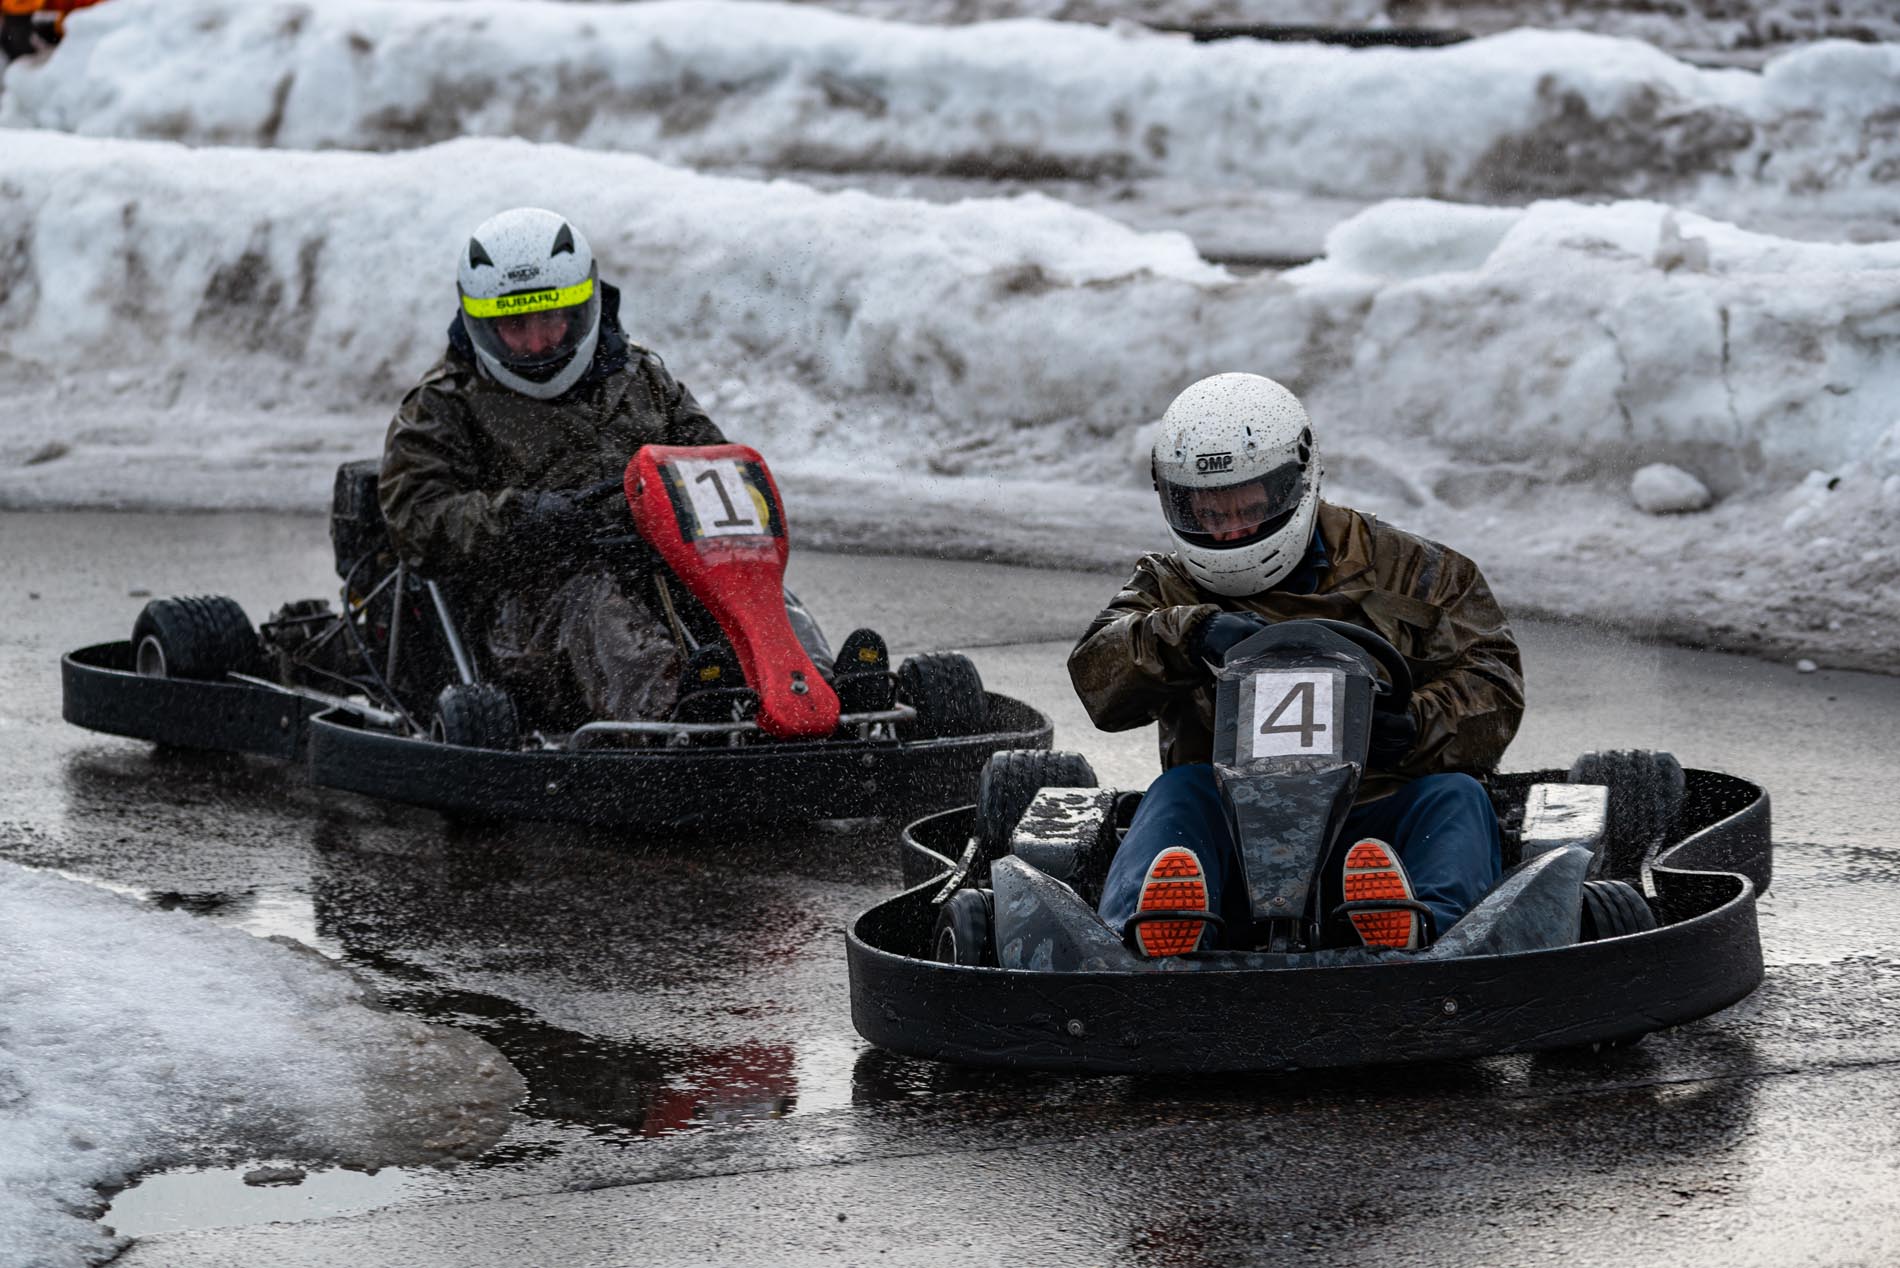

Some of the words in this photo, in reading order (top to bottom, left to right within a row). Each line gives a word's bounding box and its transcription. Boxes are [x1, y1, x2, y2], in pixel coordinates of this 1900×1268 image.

[496, 291, 560, 309] SUBARU
[1196, 455, 1233, 471] OMP
[695, 469, 754, 528] 1
[1260, 681, 1327, 748] 4
